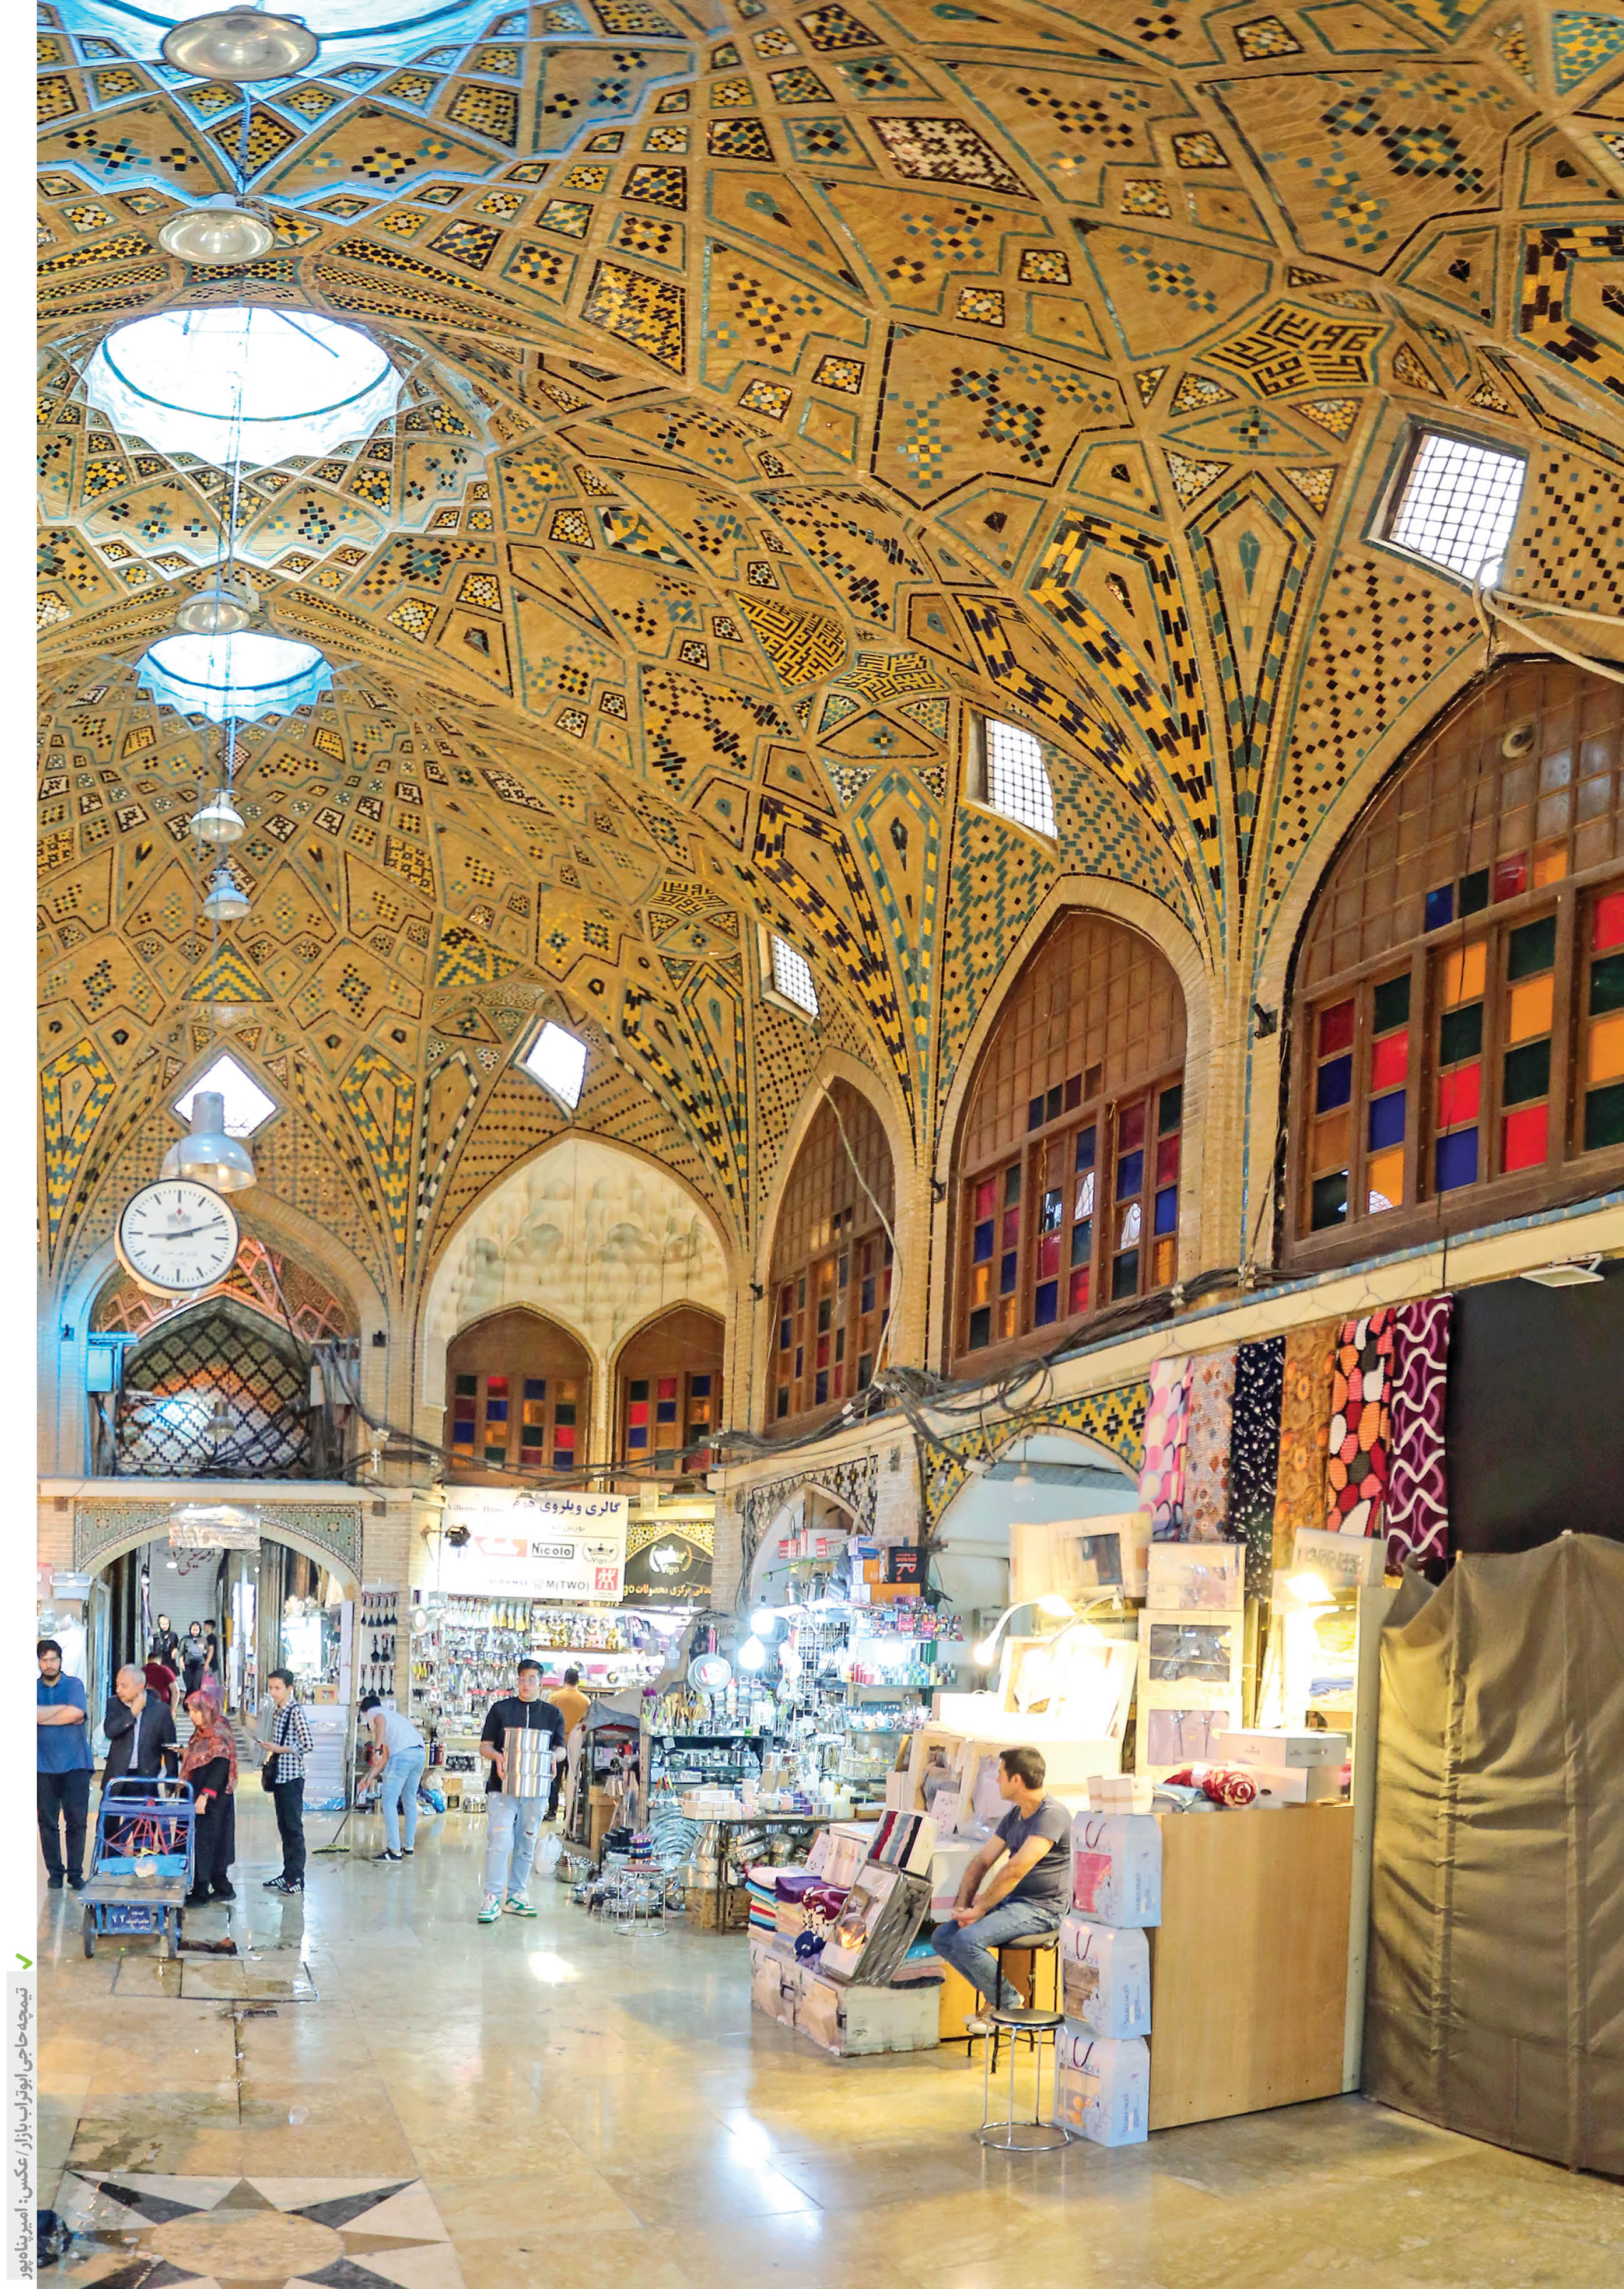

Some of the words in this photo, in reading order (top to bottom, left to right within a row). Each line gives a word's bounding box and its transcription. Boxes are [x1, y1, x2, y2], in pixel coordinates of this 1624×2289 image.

[539, 1499, 581, 1516] ویلروی
[584, 1501, 621, 1517] گالری
[532, 1542, 571, 1556] Nicolo
[546, 1580, 589, 1592] M(TWO)
[623, 1584, 635, 1596] go
